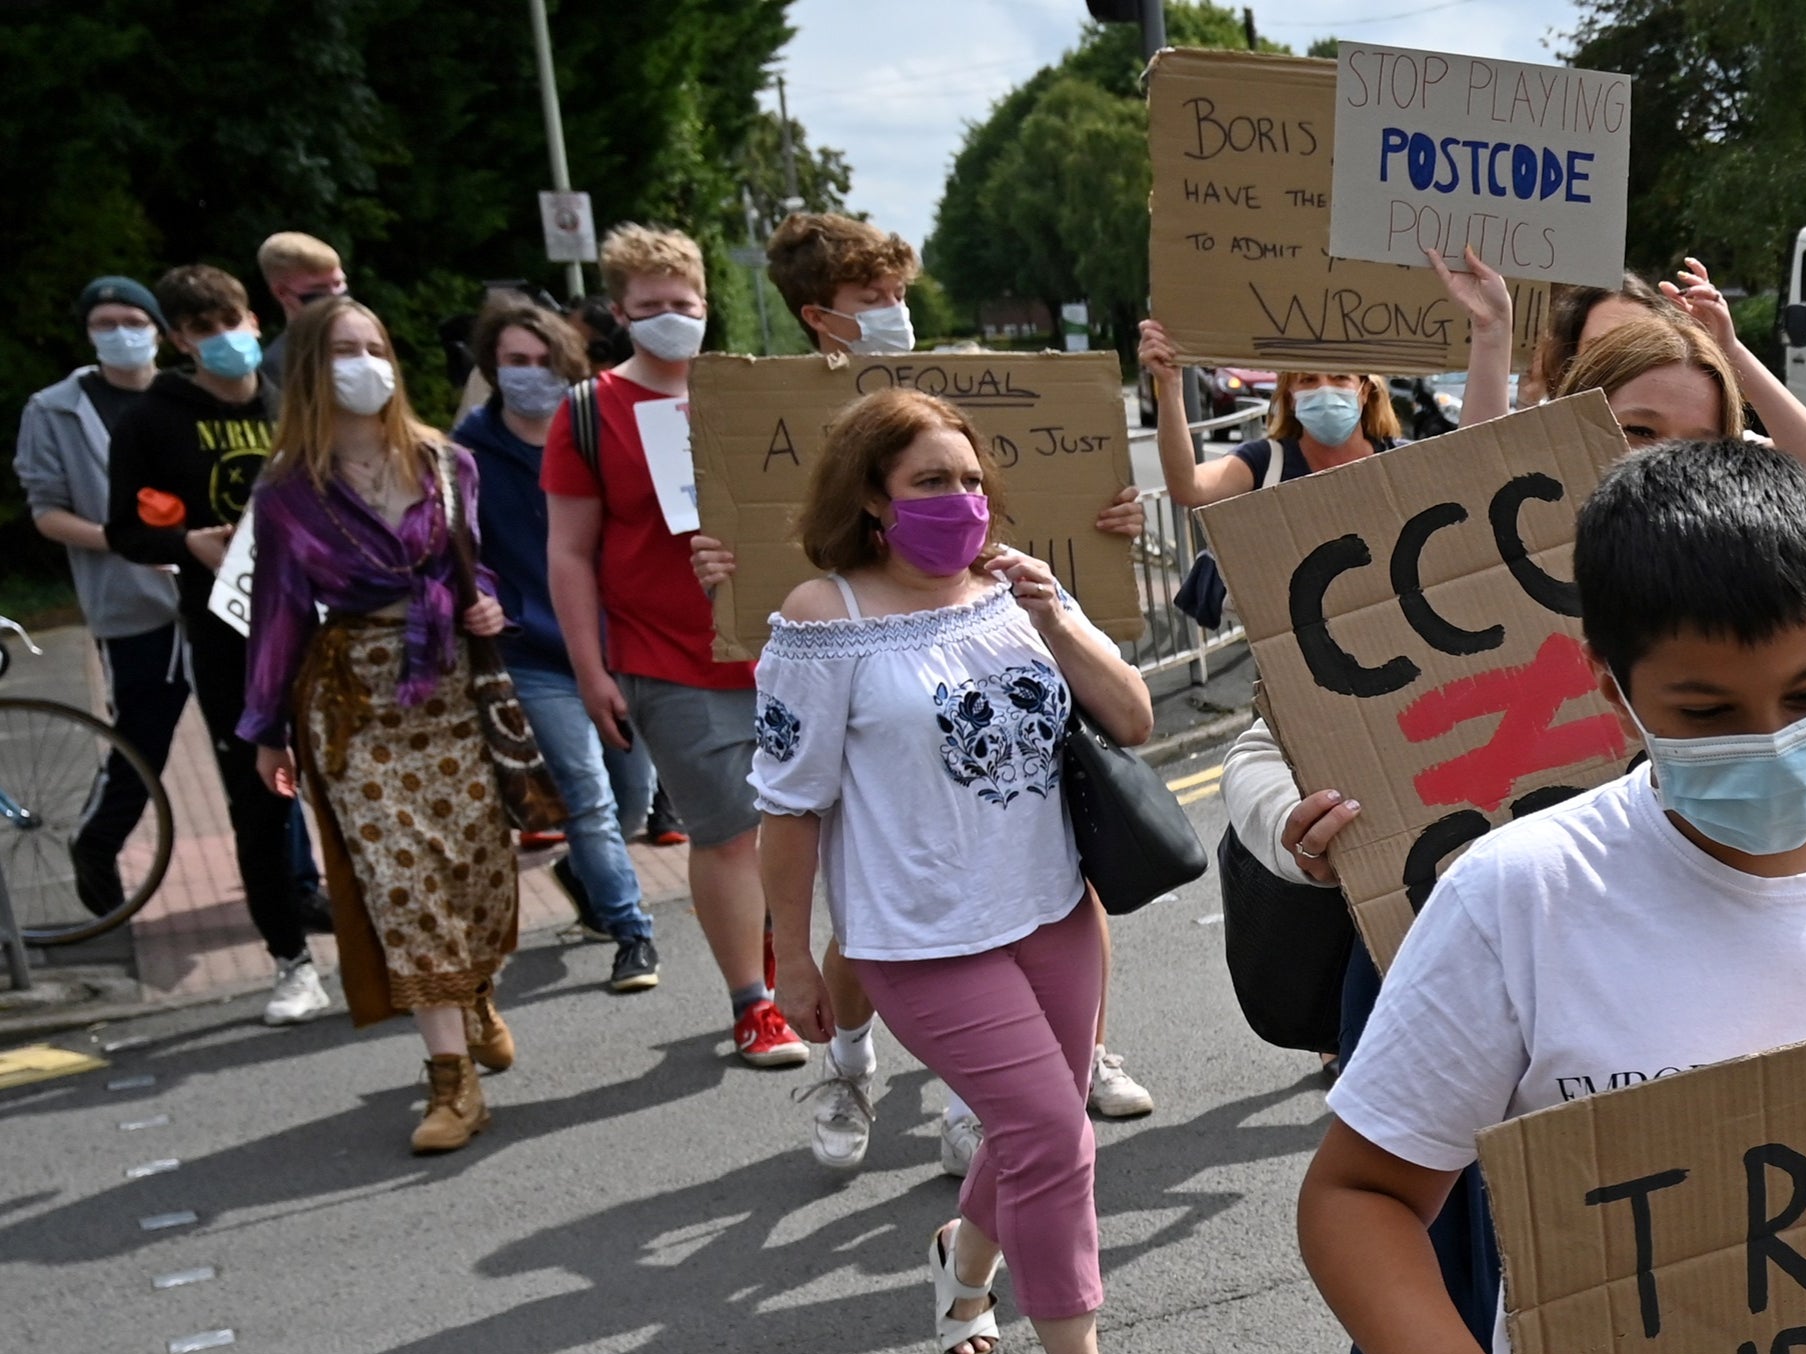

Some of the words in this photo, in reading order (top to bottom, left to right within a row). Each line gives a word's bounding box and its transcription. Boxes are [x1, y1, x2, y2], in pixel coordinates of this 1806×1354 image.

[1347, 50, 1449, 109] STOP
[1466, 60, 1626, 134] PLAYING
[1182, 97, 1317, 160] BORIS
[1184, 179, 1262, 209] HAVE
[1285, 189, 1328, 209] THE
[1380, 127, 1596, 204] POSTCODE
[1186, 232, 1216, 251] TO
[1231, 236, 1303, 261] ADMIT
[1387, 200, 1556, 270] POLITICS
[1248, 281, 1453, 344] WRONG
[763, 417, 800, 473] A
[1029, 427, 1112, 457] JUST
